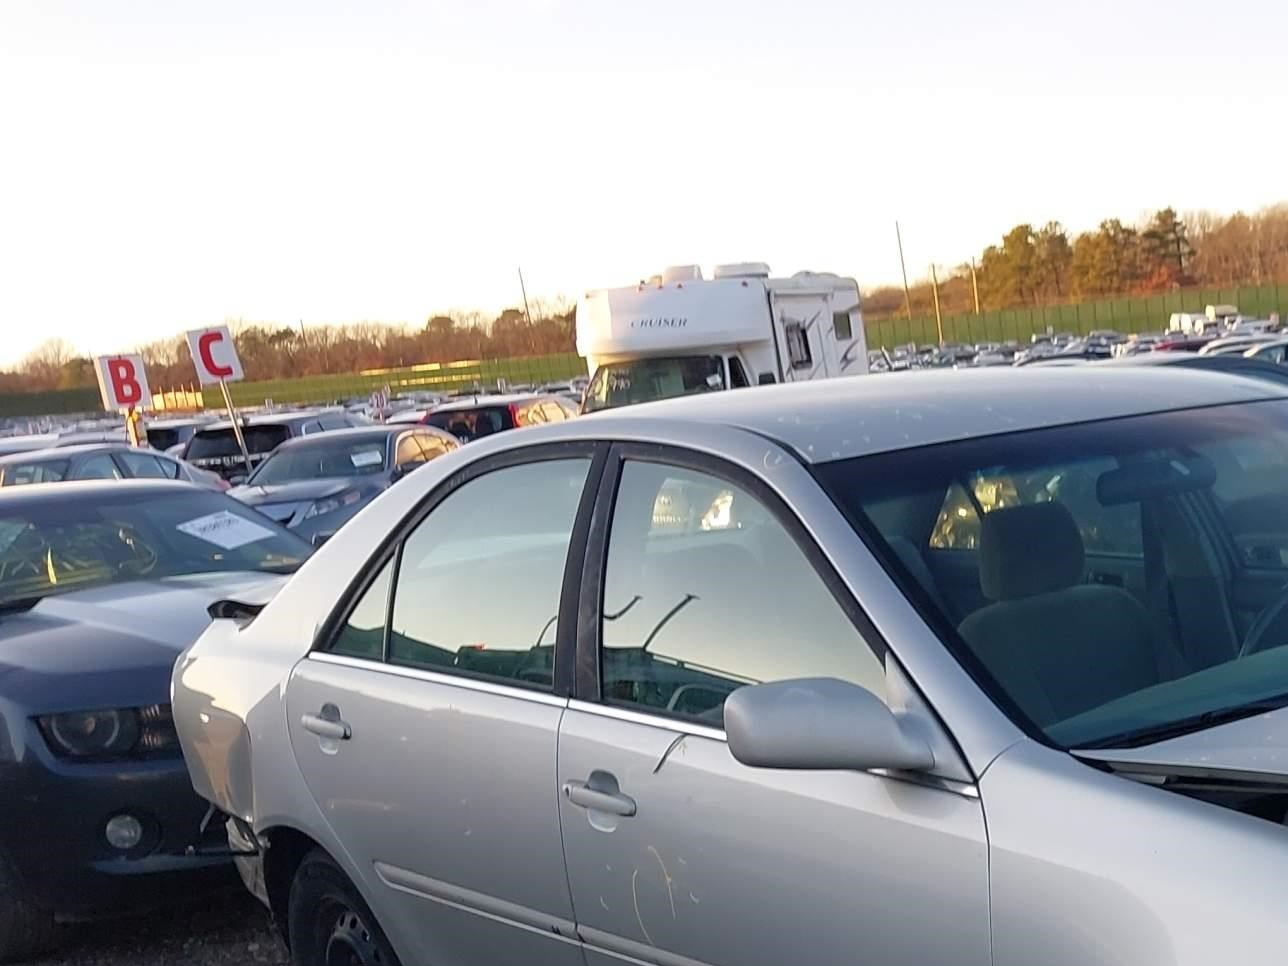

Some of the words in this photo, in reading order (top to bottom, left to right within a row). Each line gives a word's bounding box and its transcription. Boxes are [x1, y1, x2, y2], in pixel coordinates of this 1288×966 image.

[630, 317, 688, 329] CRUISER
[198, 332, 234, 377] C
[107, 359, 142, 404] B
